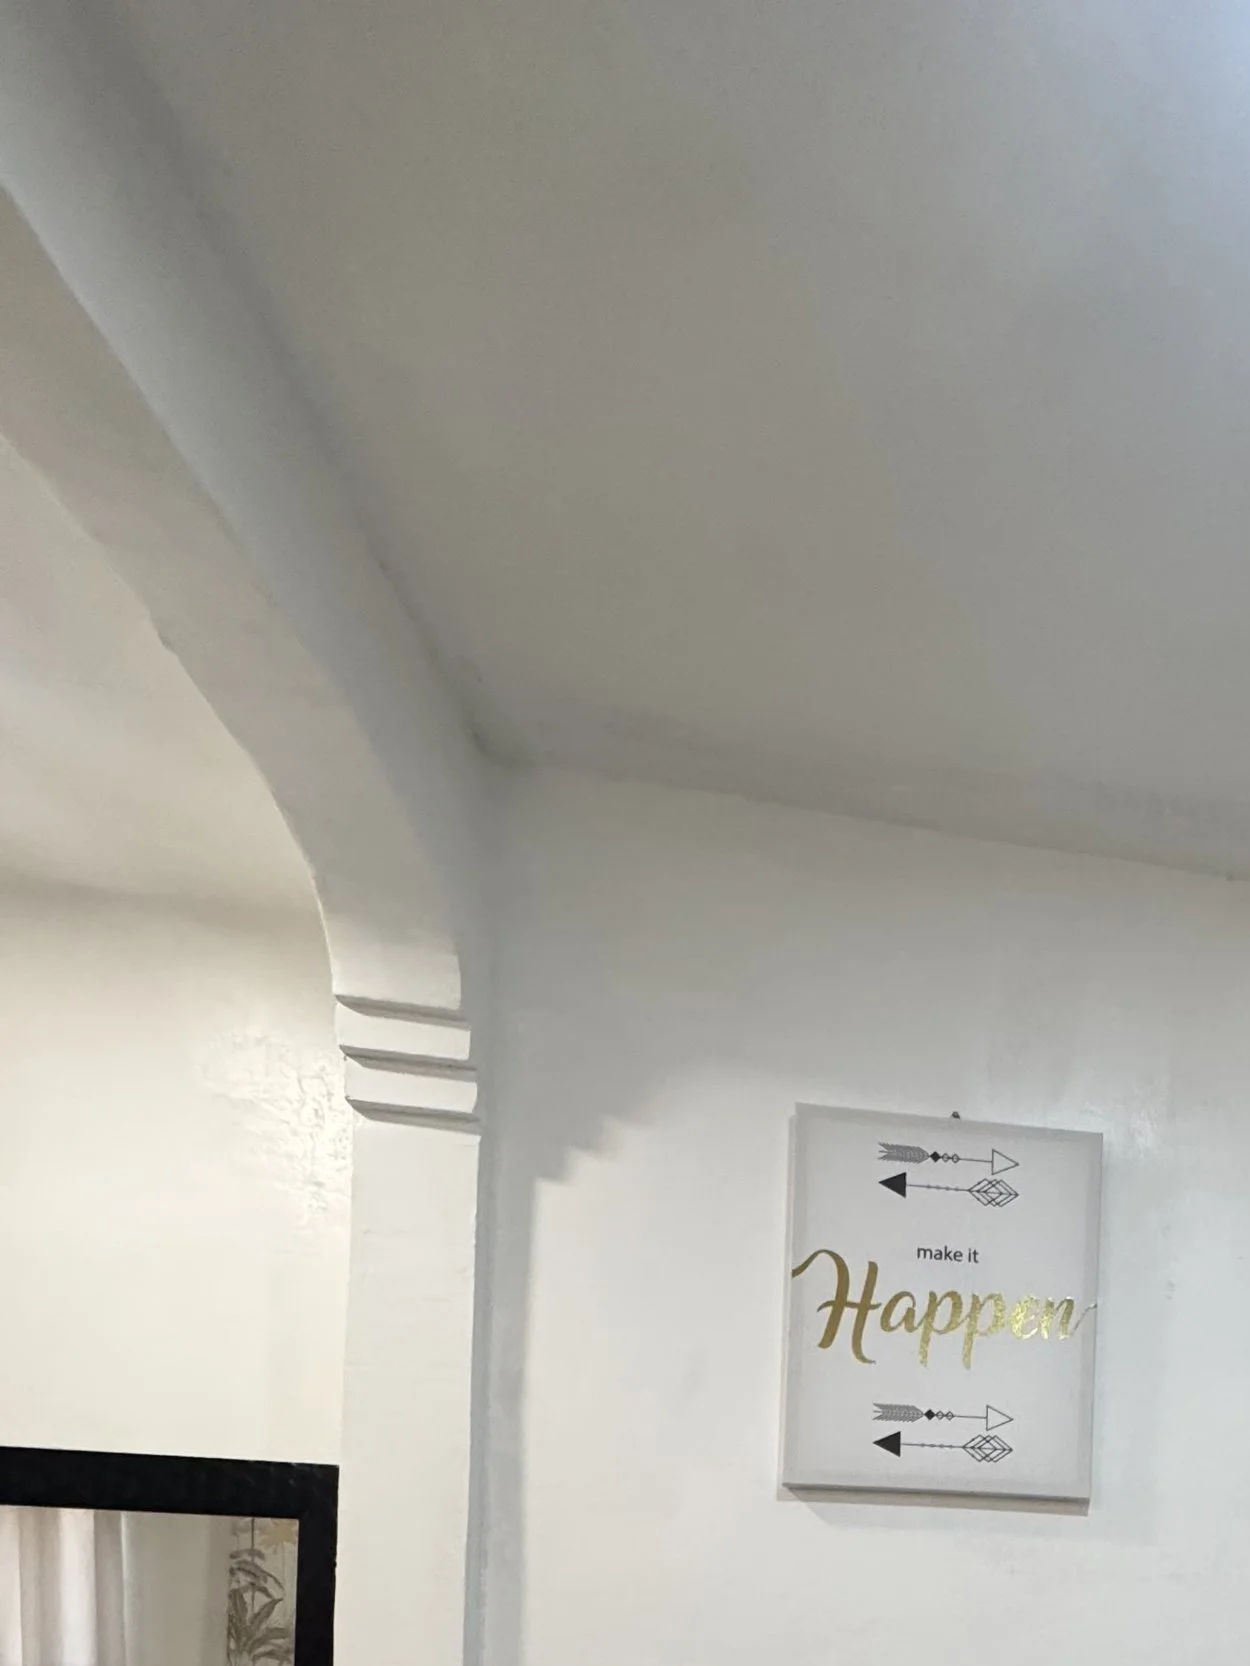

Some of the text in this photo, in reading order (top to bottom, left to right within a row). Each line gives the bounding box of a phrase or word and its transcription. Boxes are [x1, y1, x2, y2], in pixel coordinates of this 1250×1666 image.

[917, 1245, 980, 1264] make it
[792, 1249, 1097, 1370] Happen
